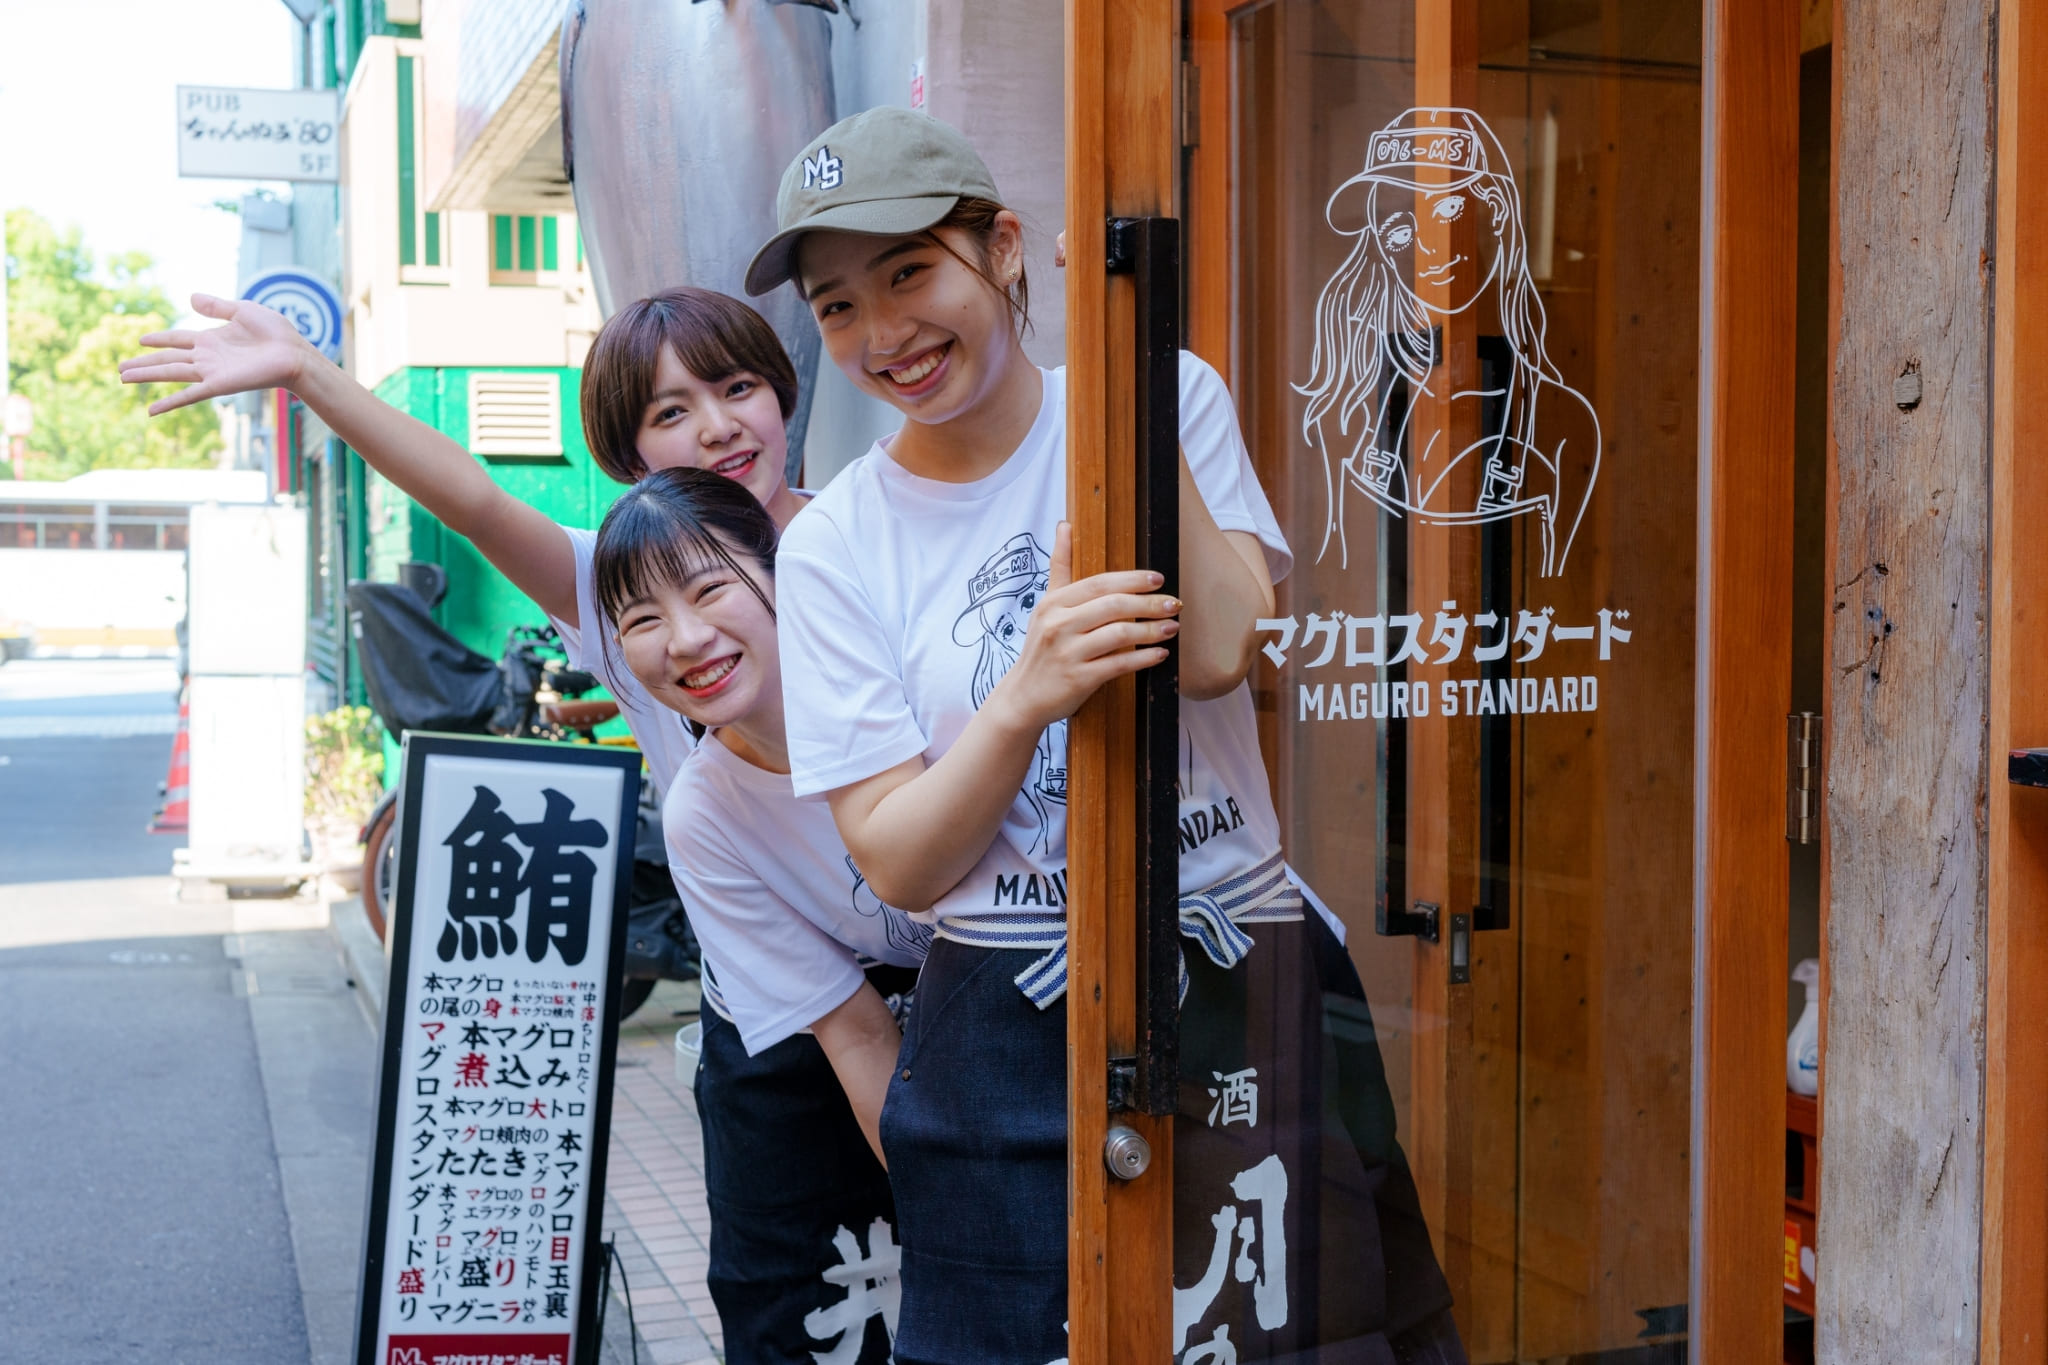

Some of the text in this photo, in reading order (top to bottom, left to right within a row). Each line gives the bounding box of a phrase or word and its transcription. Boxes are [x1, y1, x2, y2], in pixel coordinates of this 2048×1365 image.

[187, 92, 241, 112] PUB
[299, 152, 331, 173] 5F
[1376, 138, 1465, 162] 096-MS
[975, 553, 1029, 594] 096-MS
[1255, 599, 1633, 669] マグロスタンダード
[1299, 676, 1598, 722] MAGURO STANDARD
[994, 796, 1245, 907] MAGU NDAR
[437, 785, 609, 966] 鮪
[423, 972, 504, 994] 本マグロ
[420, 996, 502, 1019] の尾の身
[458, 1020, 575, 1051] 本マグロ
[454, 1052, 572, 1089] 煮込み
[444, 1096, 586, 1120] 本マグロ大トロ
[1207, 1066, 1259, 1128] 酒
[436, 1147, 527, 1177] たたき
[465, 1187, 523, 1202] マグロの
[463, 1204, 521, 1220] エラブタ
[544, 1128, 583, 1319] 本マグロ目玉裏
[431, 1183, 458, 1298] 本マグロレバー
[461, 1226, 518, 1248] マグロ
[458, 1255, 516, 1289] 盛り
[428, 1298, 521, 1324] マグニラ
